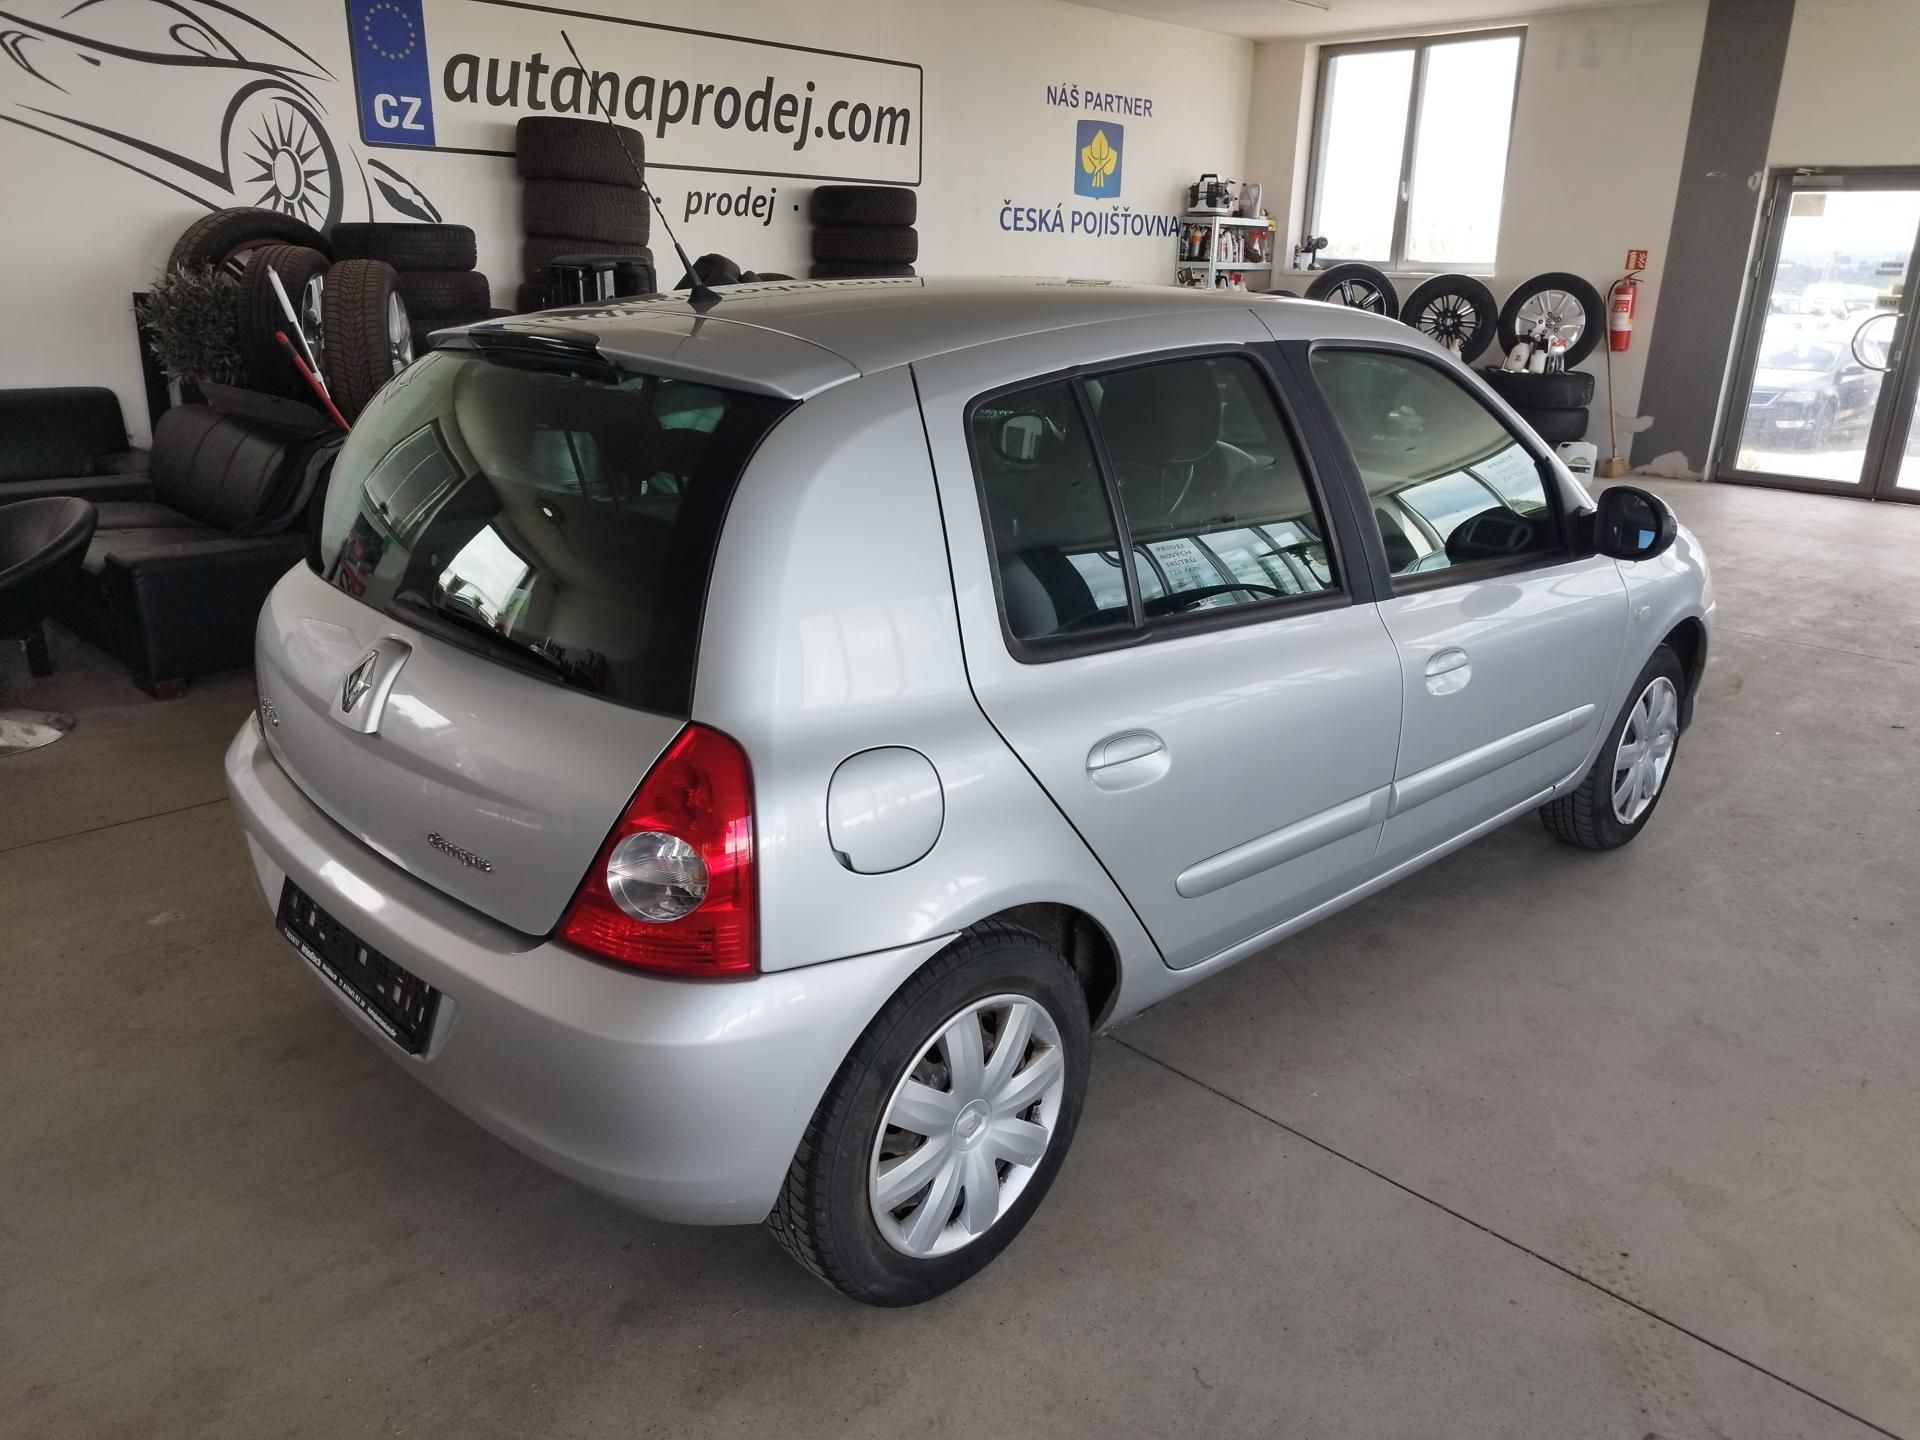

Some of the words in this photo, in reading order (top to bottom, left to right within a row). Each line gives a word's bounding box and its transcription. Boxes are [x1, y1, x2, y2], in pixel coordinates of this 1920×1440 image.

[374, 93, 425, 132] CZ
[443, 51, 911, 151] autanaprodej.com
[1047, 83, 1080, 109] NÁŠ
[1084, 91, 1153, 118] PARTNER
[684, 187, 776, 227] prodej
[999, 199, 1065, 233] ČESKÁ
[1070, 206, 1181, 238] POJIŠŤOVNA
